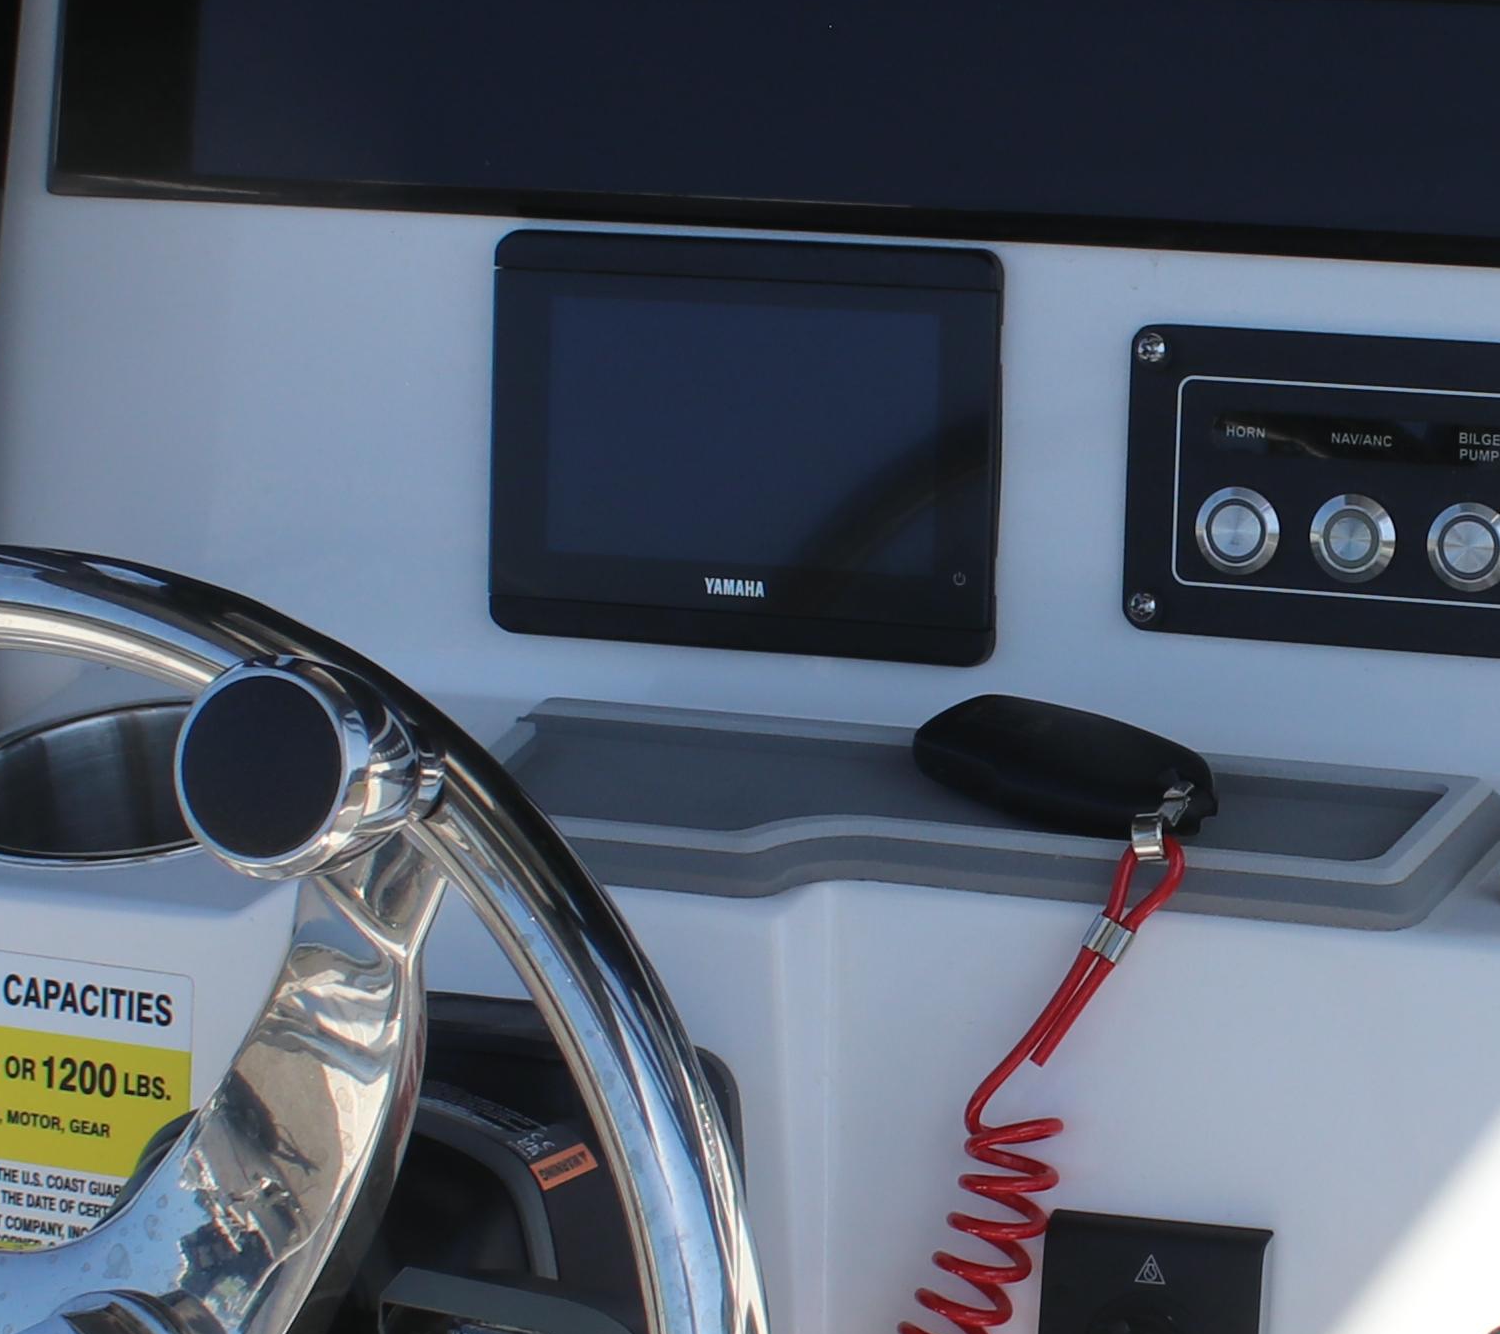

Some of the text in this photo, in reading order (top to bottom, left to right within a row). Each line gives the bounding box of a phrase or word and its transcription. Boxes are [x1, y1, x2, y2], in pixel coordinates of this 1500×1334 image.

[1226, 426, 1266, 439] HORN
[1331, 432, 1393, 448] NAV/ANC
[1459, 432, 1500, 447] BILGE
[1459, 449, 1500, 462] PUMP
[704, 577, 765, 598] YAMAHA
[3, 974, 173, 1025] CAPACITIES
[4, 1055, 36, 1081] OR
[42, 1055, 117, 1098] 1200
[123, 1072, 171, 1101] LBS.
[6, 1109, 65, 1134] MOTOR,
[69, 1118, 110, 1138] GEAR
[21, 1170, 44, 1187] U.S.
[46, 1174, 87, 1194] COAST
[87, 1180, 122, 1198] GUAR
[0, 1189, 23, 1207] THE
[26, 1193, 56, 1212] DATE
[59, 1199, 75, 1214] OF
[78, 1200, 111, 1218] CERT
[4, 1215, 65, 1240] COMPANY,
